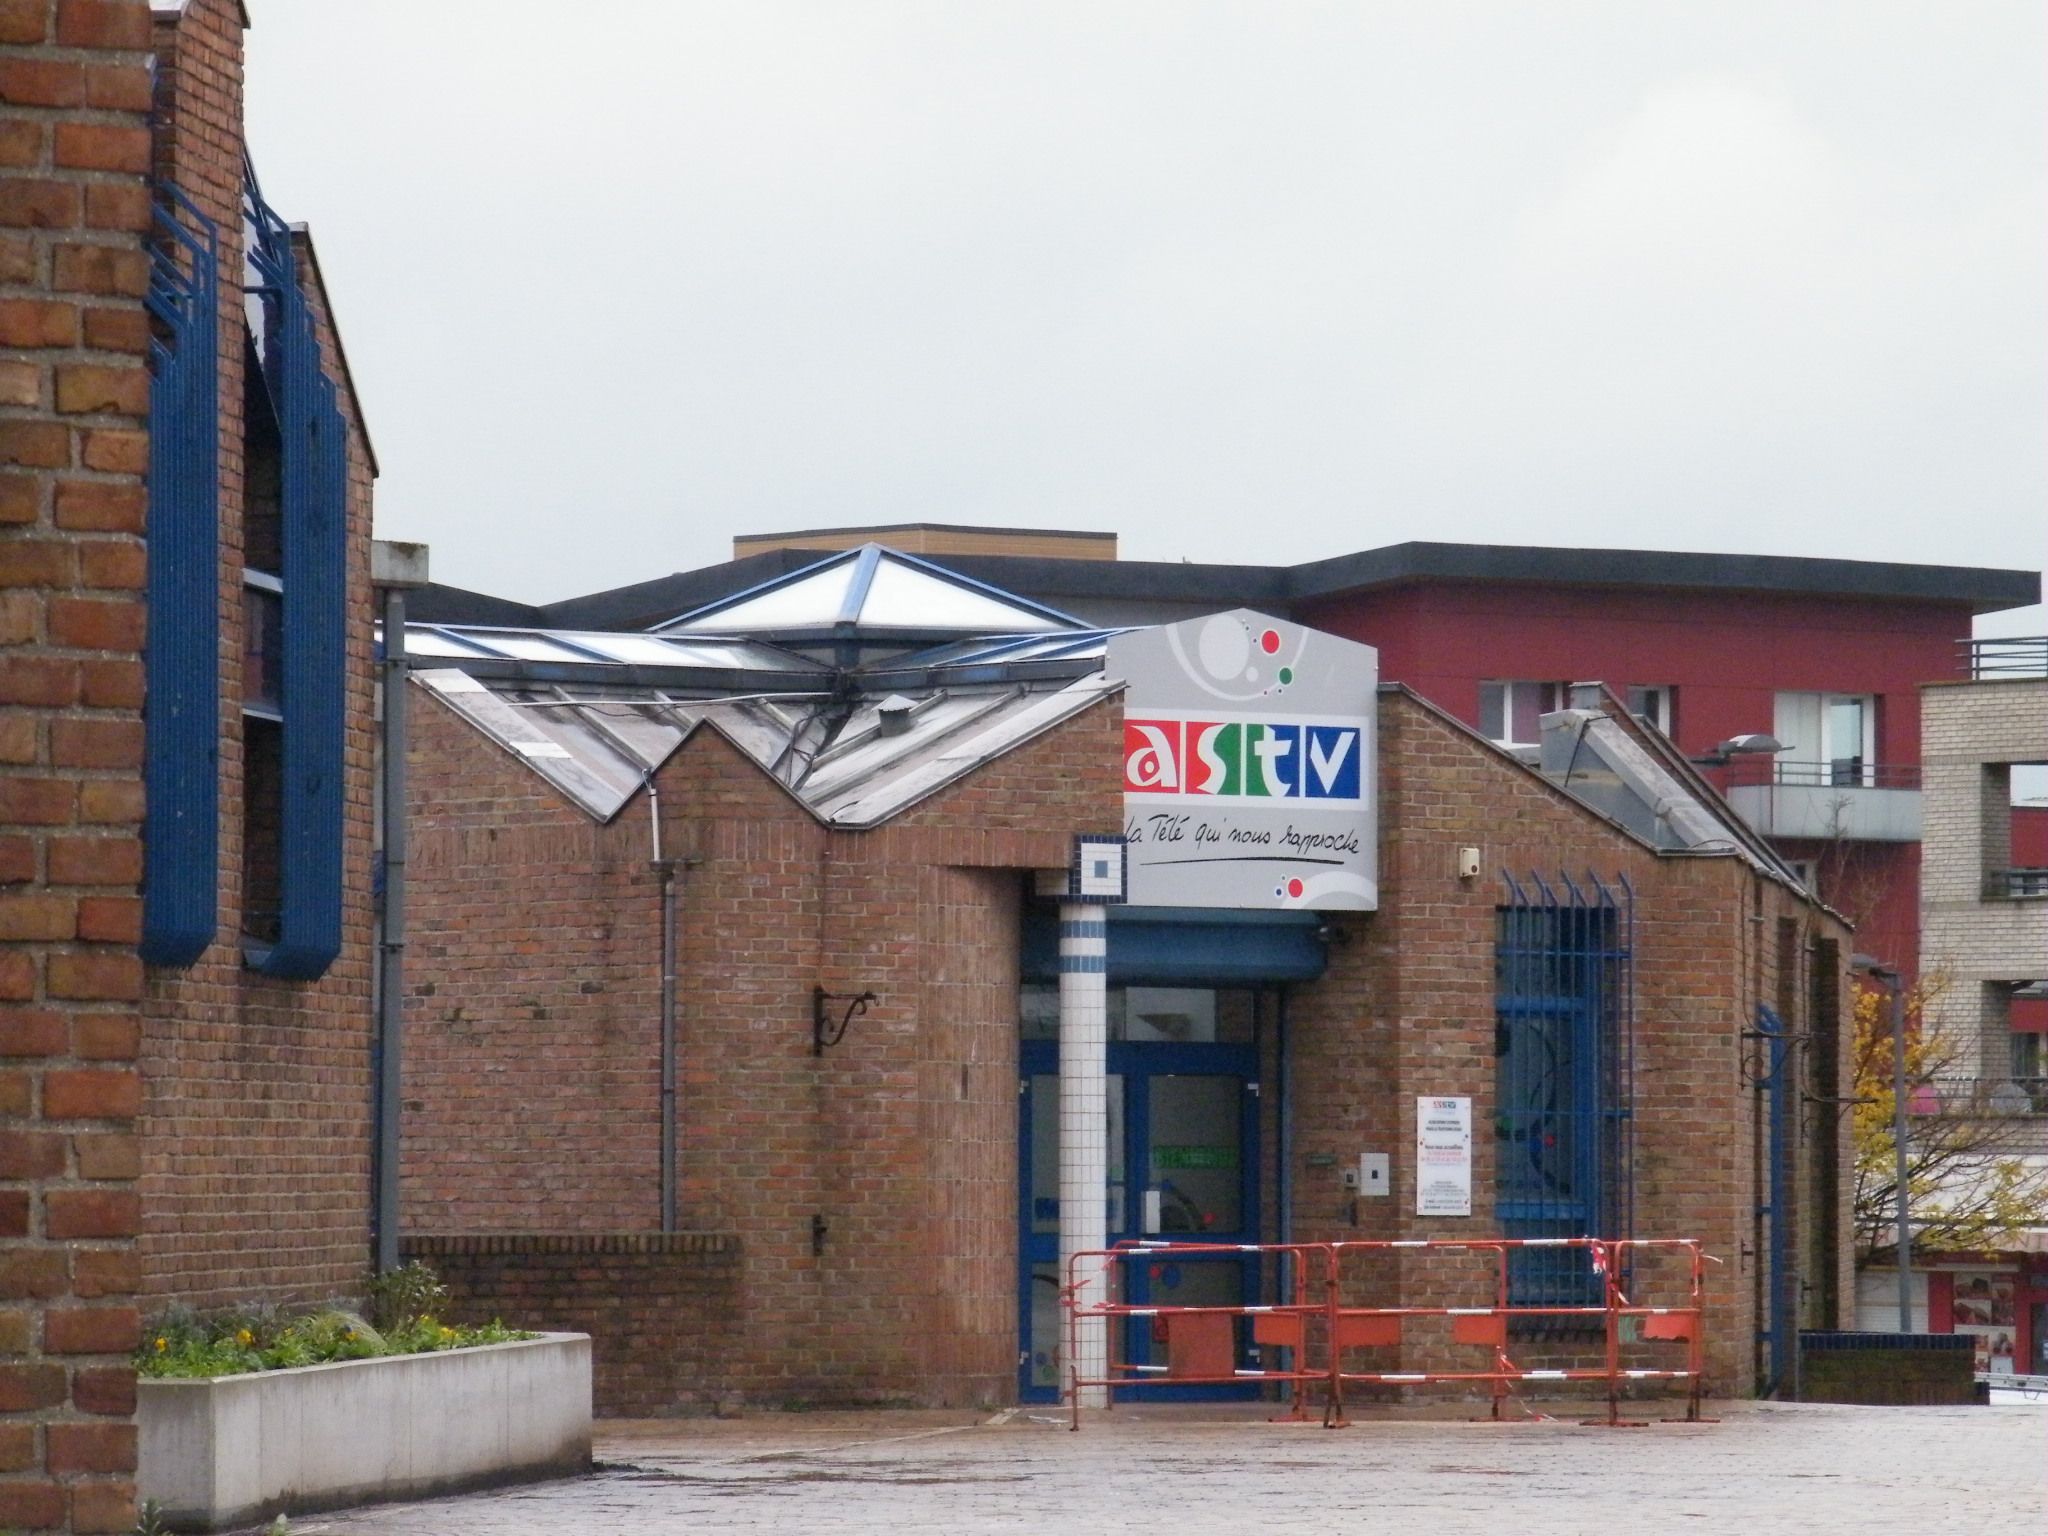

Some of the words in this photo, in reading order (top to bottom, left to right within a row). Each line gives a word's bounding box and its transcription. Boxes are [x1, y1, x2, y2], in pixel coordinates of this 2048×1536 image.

[1148, 813, 1190, 842] Télé
[1195, 816, 1227, 850] qui
[1228, 828, 1271, 845] nous
[1279, 825, 1360, 855] rapproche
